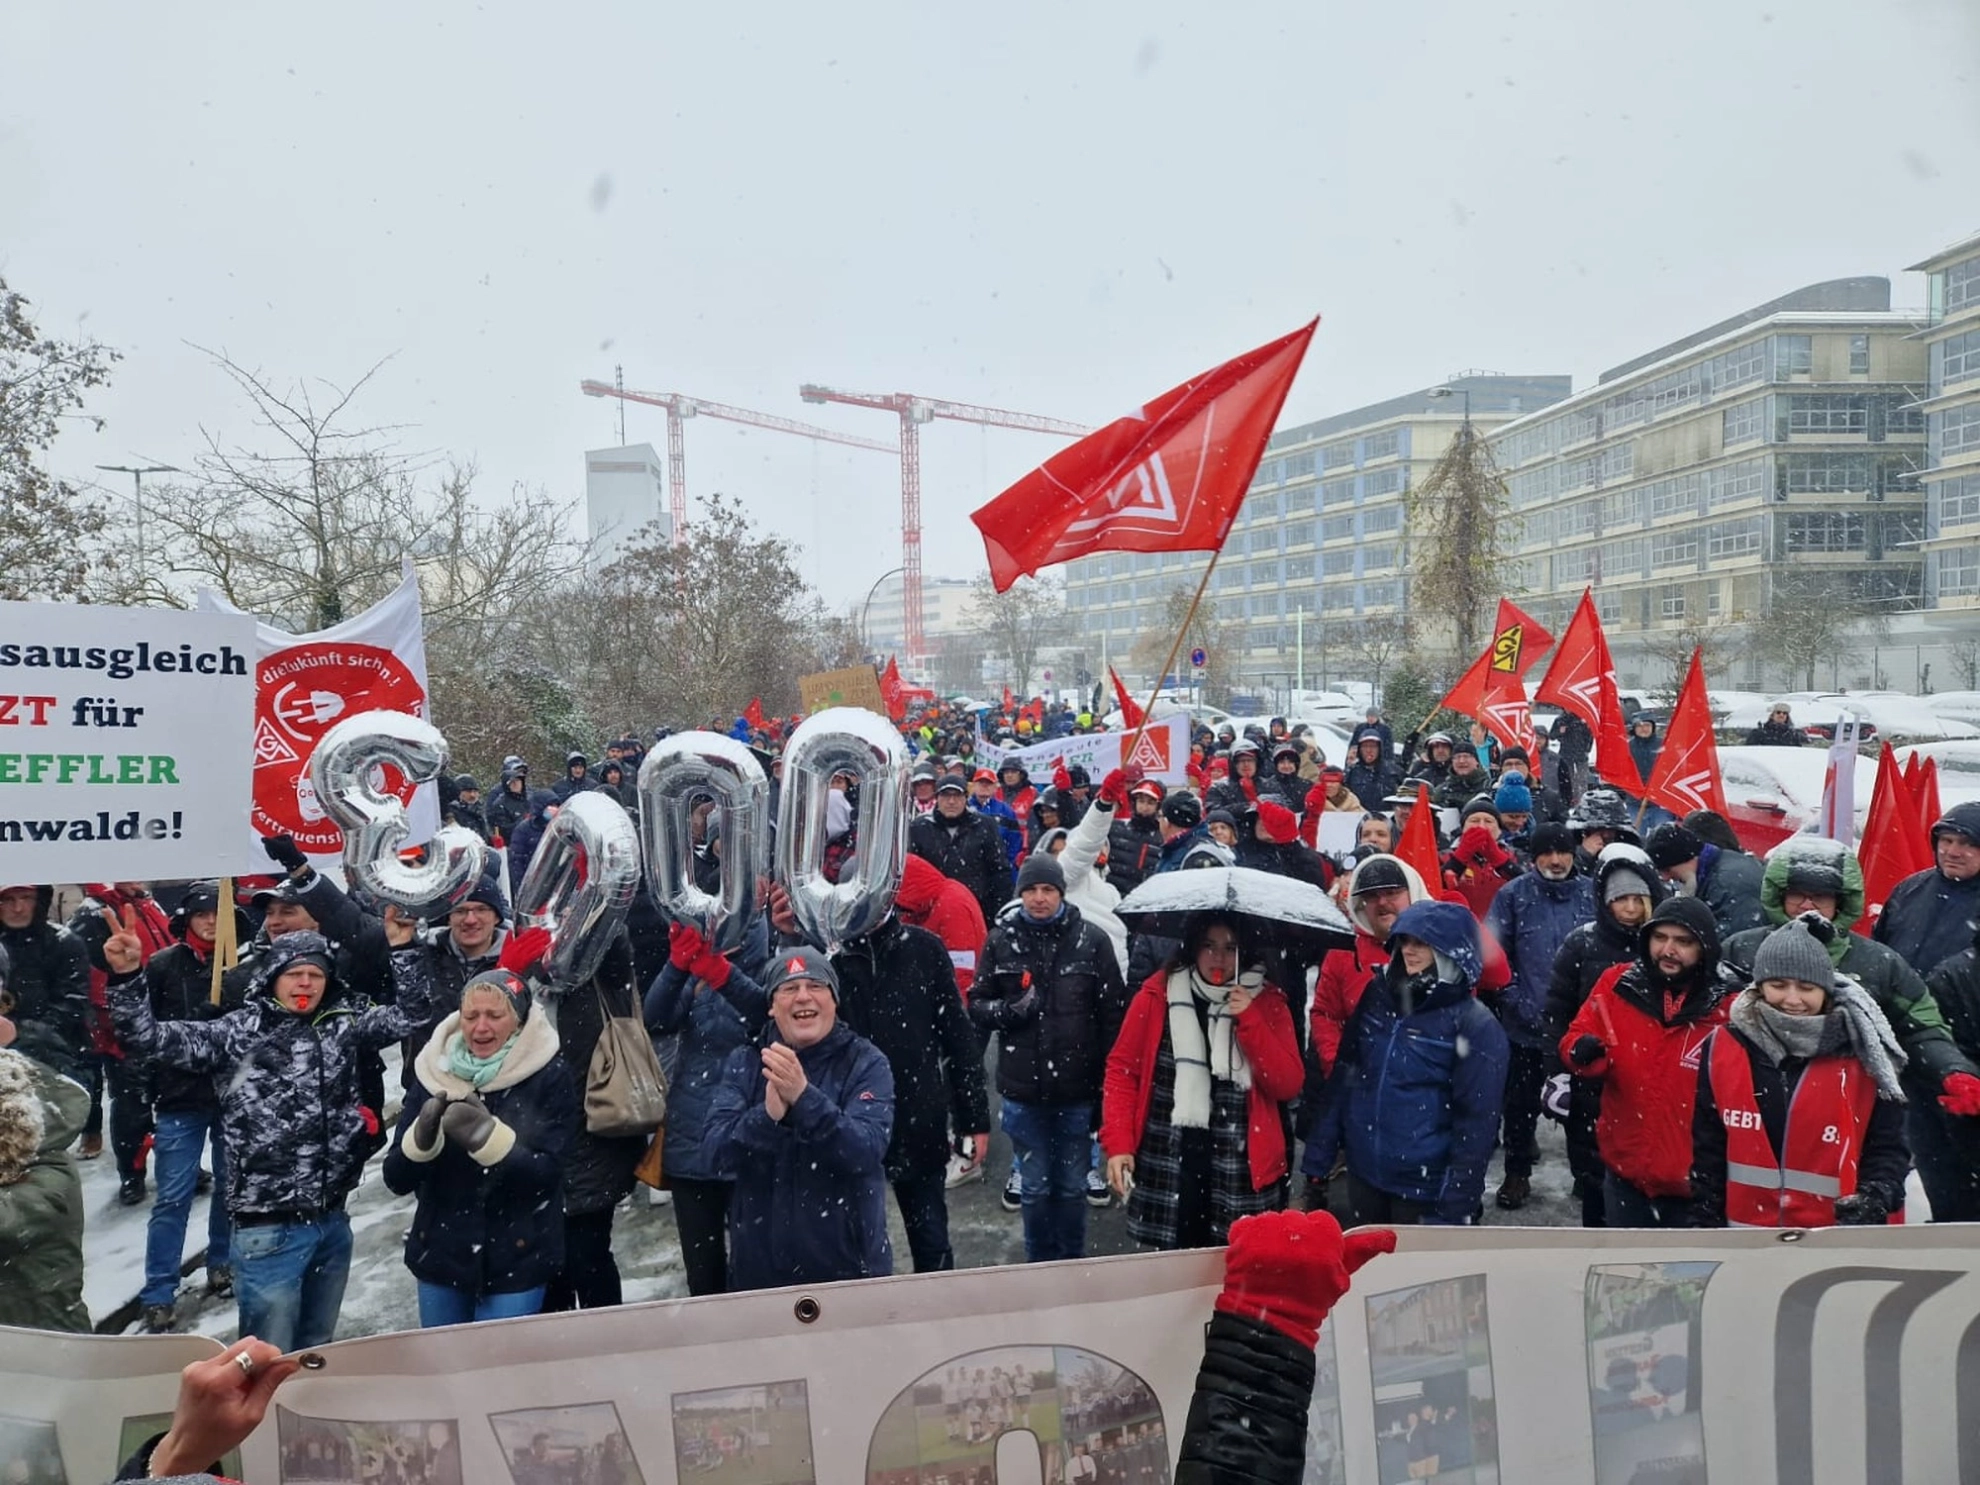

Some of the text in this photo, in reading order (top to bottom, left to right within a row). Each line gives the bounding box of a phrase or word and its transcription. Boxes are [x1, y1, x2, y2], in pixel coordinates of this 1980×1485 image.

[0, 642, 247, 679] sausgleich
[262, 665, 289, 684] die
[72, 697, 144, 727] für
[0, 754, 180, 784] EFFLER
[1722, 1108, 1762, 1131] GEBT
